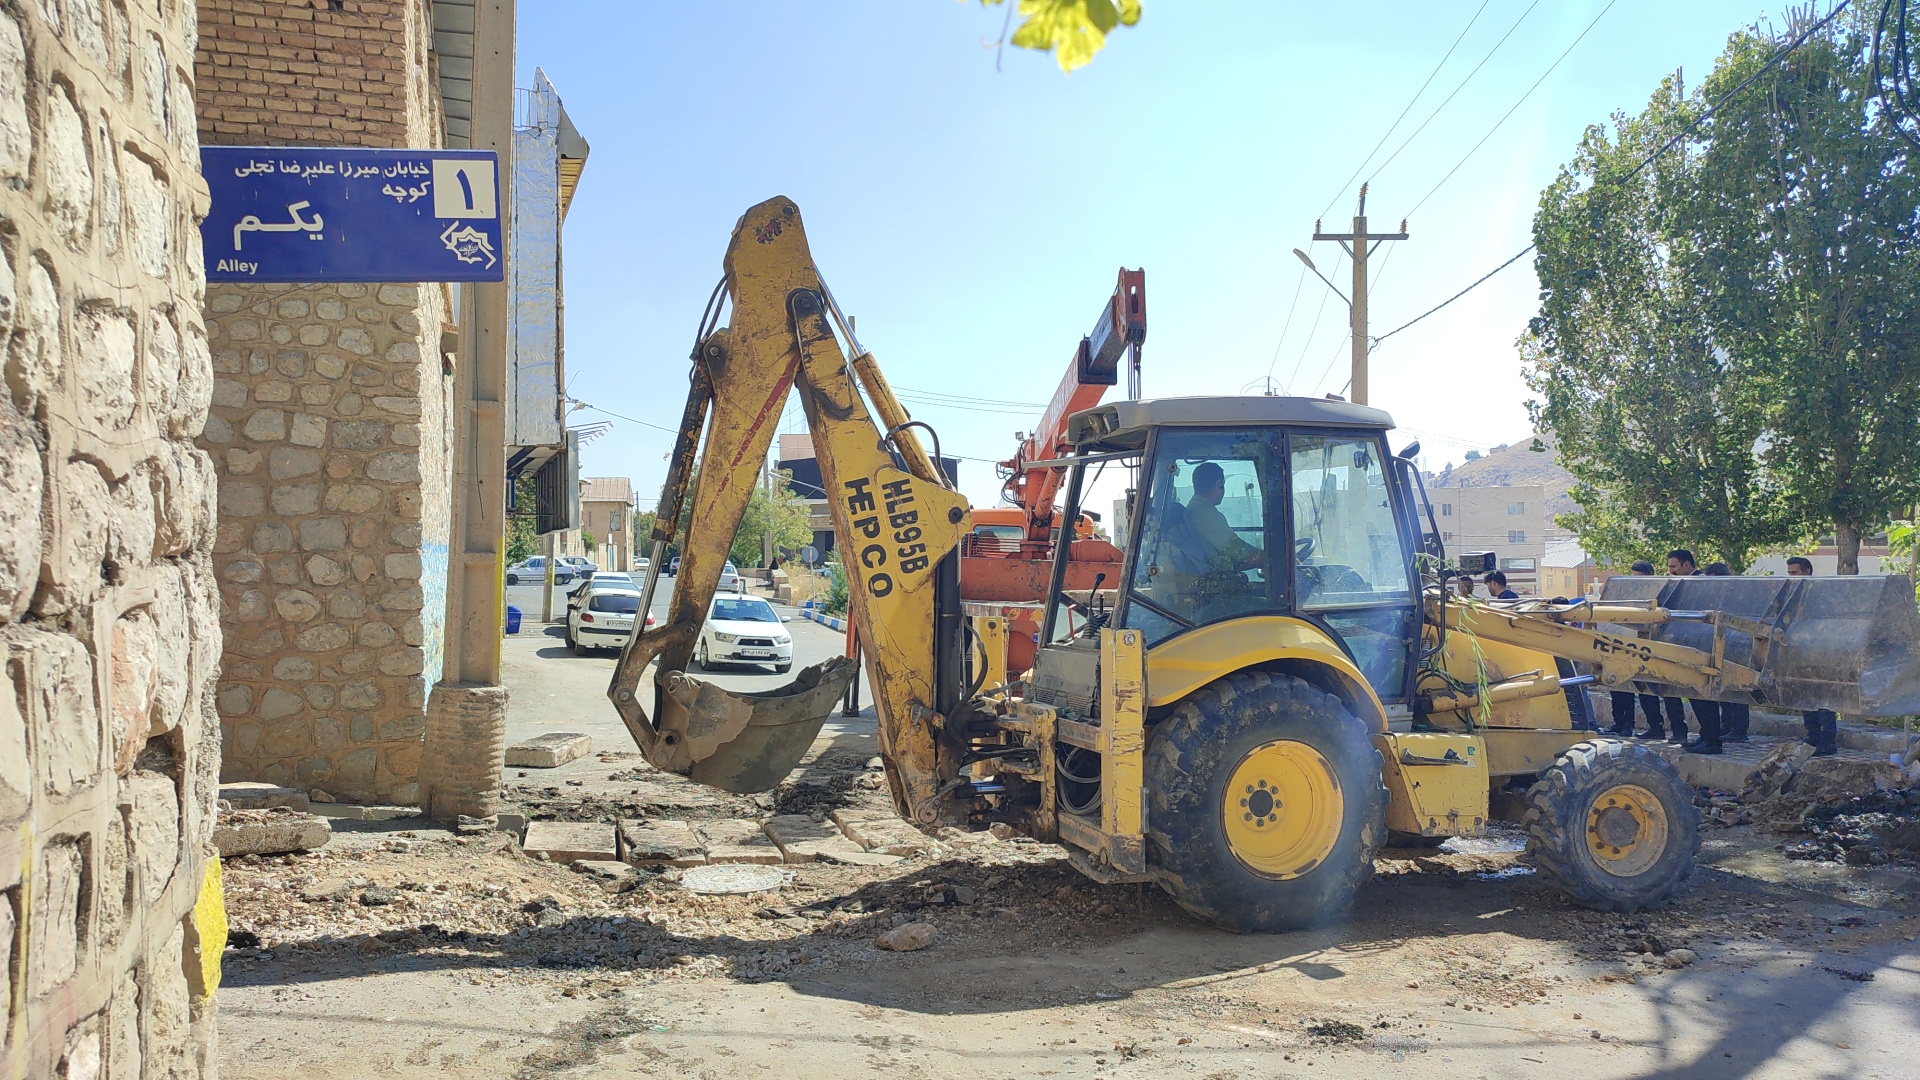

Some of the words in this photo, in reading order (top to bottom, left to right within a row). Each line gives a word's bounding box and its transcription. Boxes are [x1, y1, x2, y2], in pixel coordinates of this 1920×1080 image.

[234, 159, 275, 178] تجلی
[279, 160, 336, 179] علیرضا
[339, 160, 380, 179] میرزا
[383, 160, 431, 179] خیابان
[382, 180, 432, 204] کوچه
[233, 200, 325, 251] یکم
[216, 259, 259, 276] Alley
[881, 478, 930, 575] HLB95B
[843, 476, 894, 599] HEPCO
